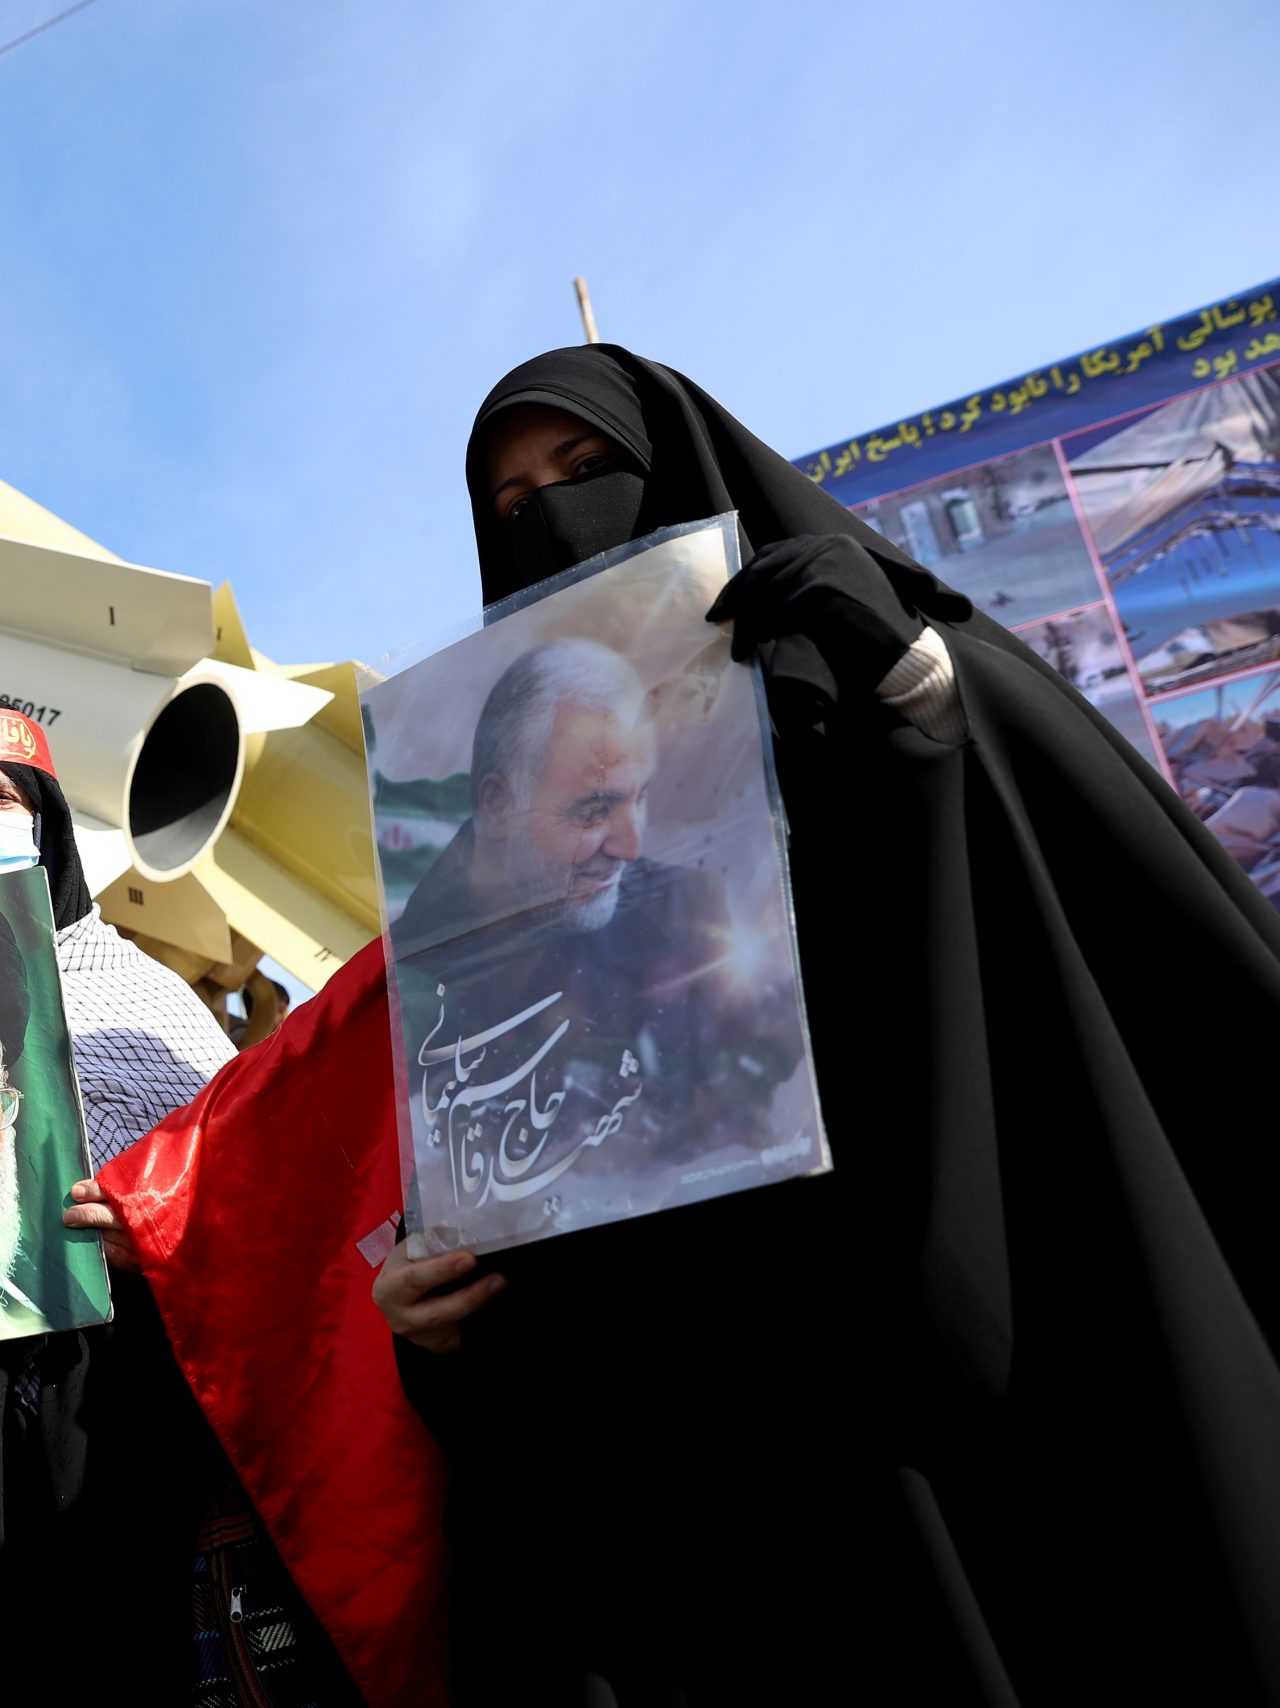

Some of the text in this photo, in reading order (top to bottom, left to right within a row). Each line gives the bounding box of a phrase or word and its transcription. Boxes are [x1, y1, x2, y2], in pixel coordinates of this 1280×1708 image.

[1079, 324, 1164, 374] آمریکا
[990, 372, 1047, 415] نابود
[1050, 366, 1081, 394] را
[806, 439, 860, 484] ایران
[865, 421, 923, 461] پاسخ
